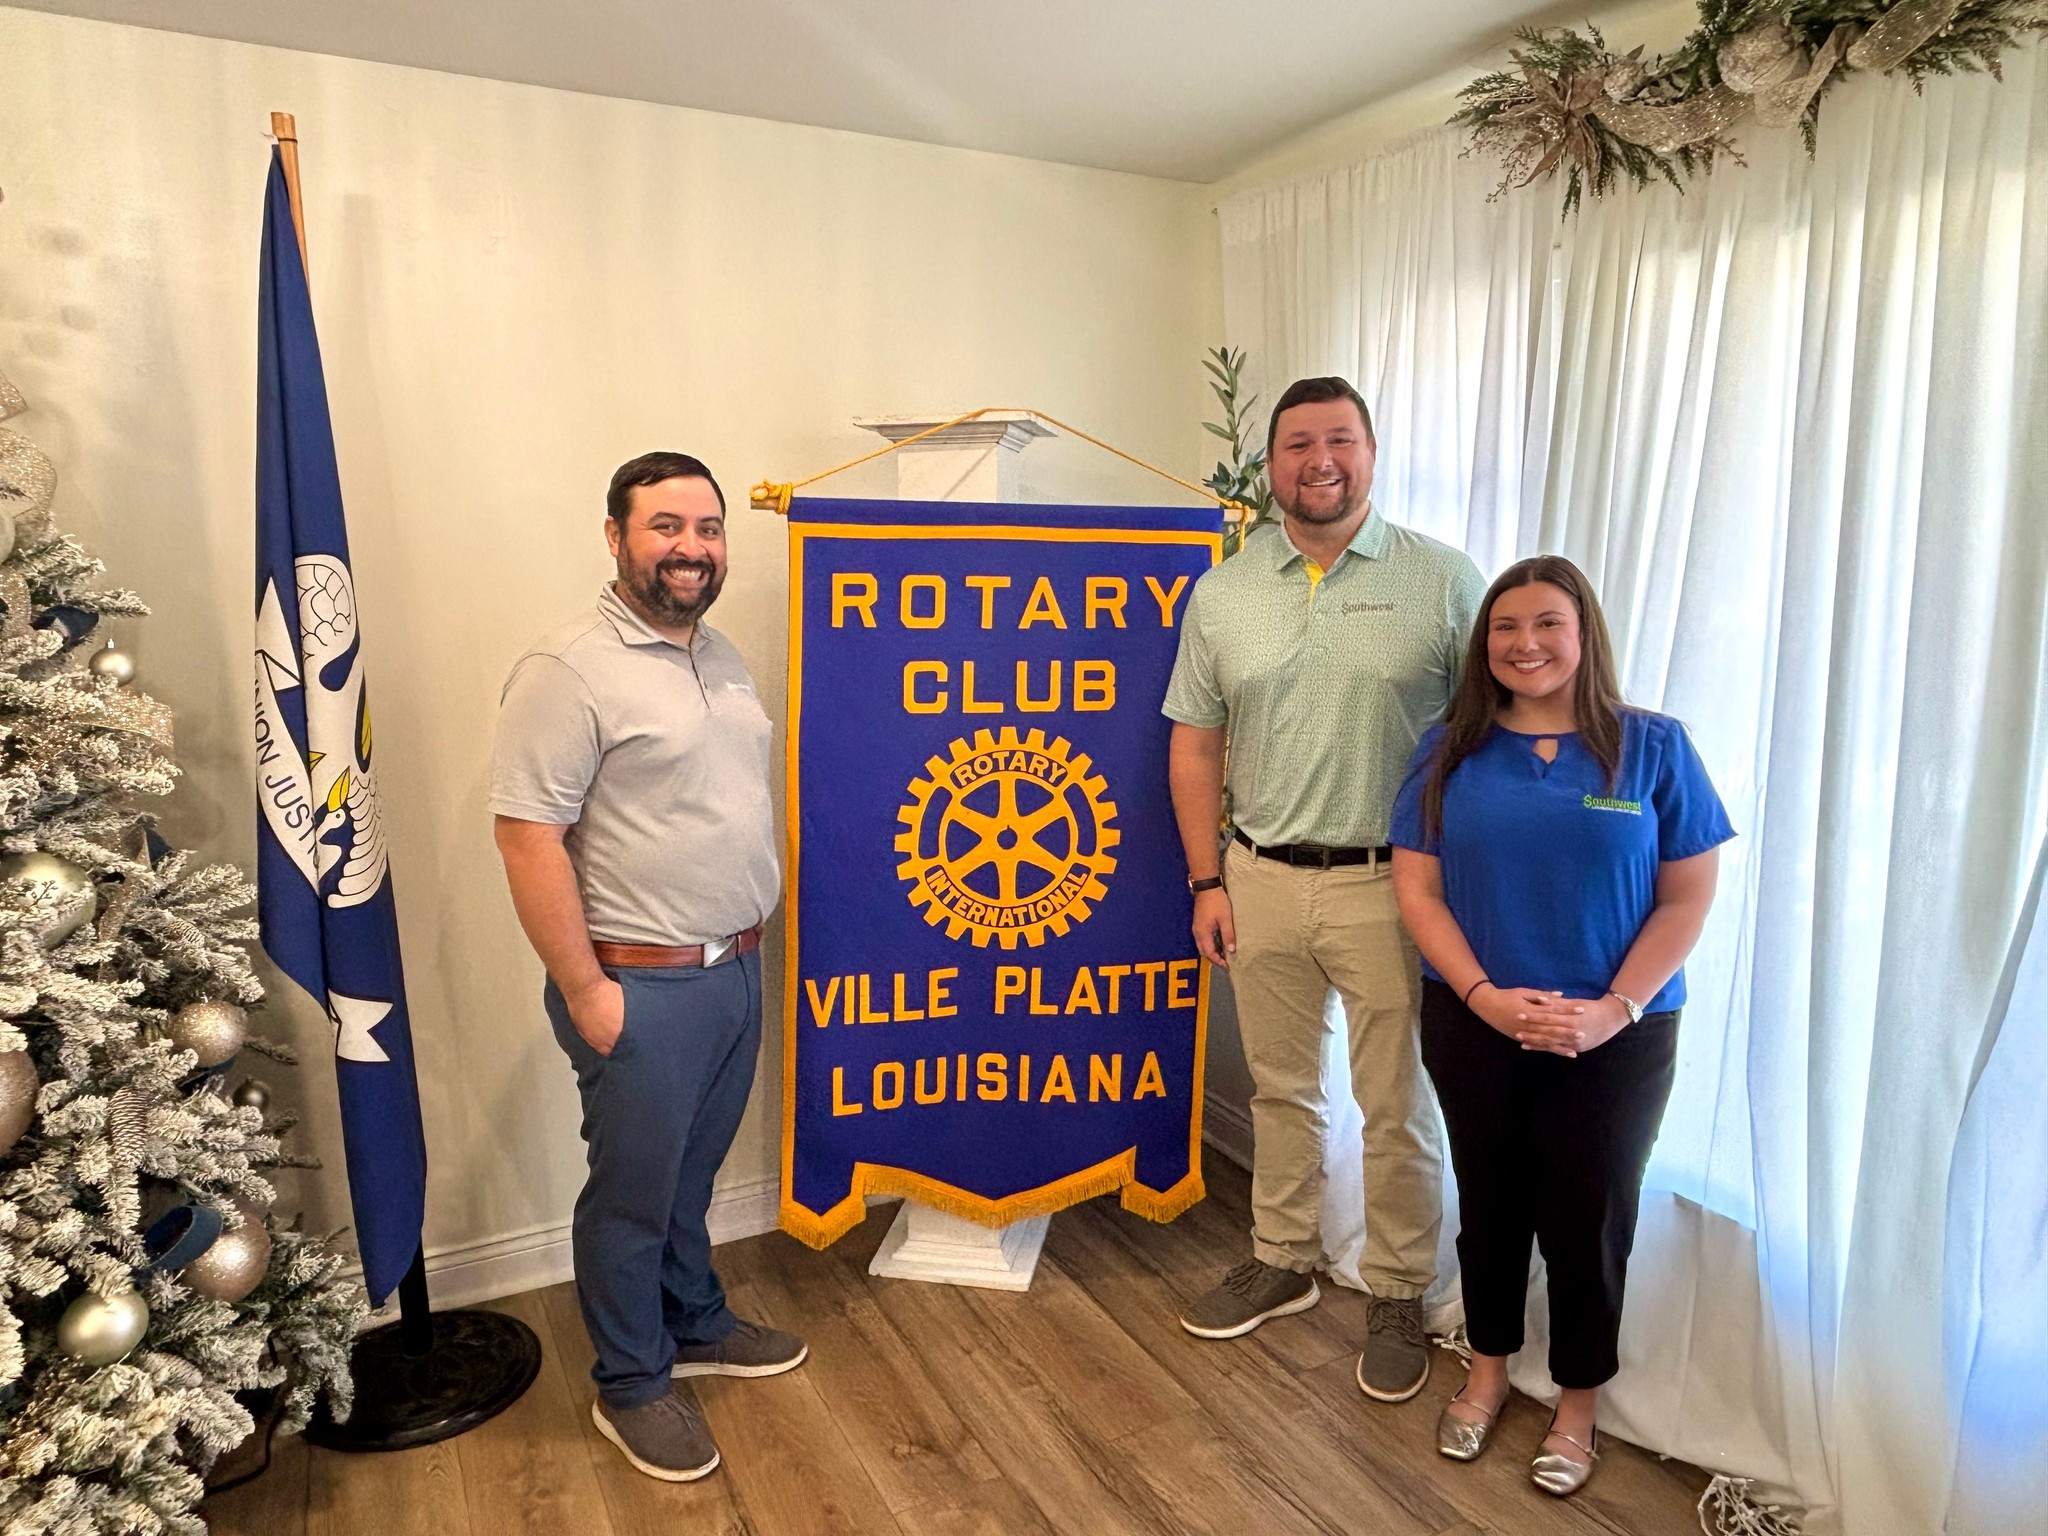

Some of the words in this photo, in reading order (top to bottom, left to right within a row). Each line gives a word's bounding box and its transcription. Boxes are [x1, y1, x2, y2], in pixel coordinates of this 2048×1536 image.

[832, 573, 1189, 629] ROTARY
[904, 660, 1115, 714] CLUB
[954, 751, 1066, 787] ROTARY
[1583, 794, 1641, 812] Southwest
[926, 869, 1088, 928] INTERNATIONAL
[805, 968, 958, 1027] VILLE
[995, 959, 1196, 1014] PLATTE
[833, 1052, 1166, 1116] LOUISIANA
